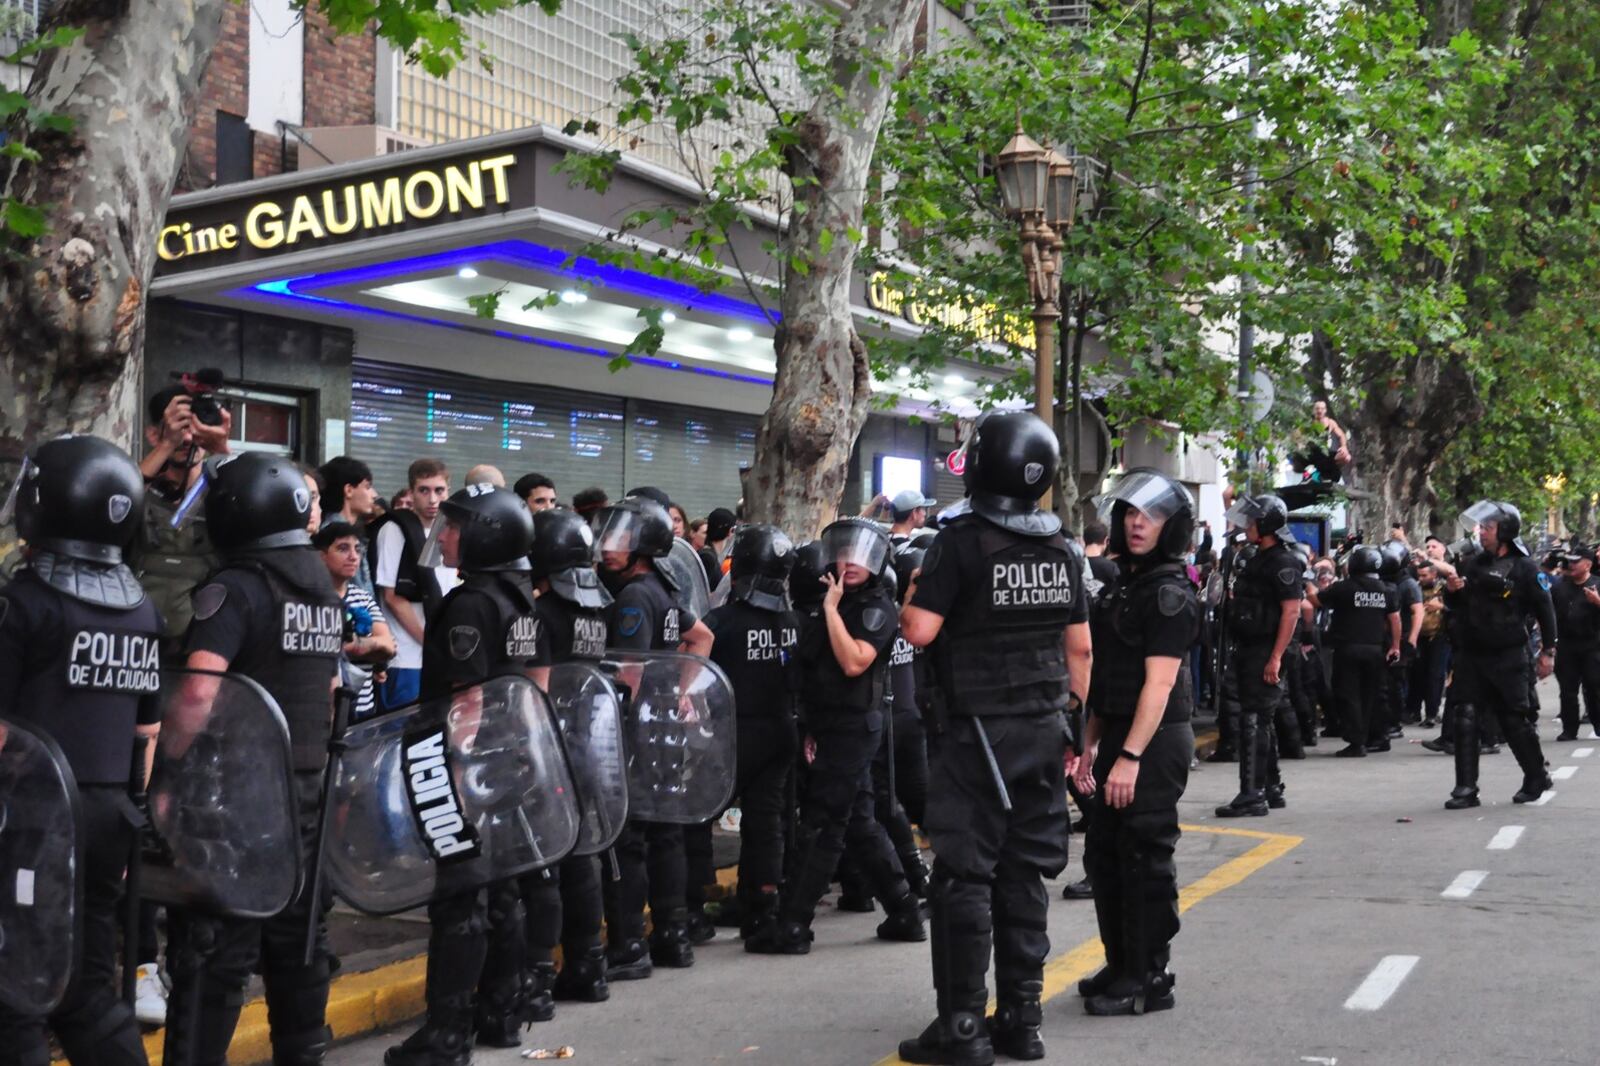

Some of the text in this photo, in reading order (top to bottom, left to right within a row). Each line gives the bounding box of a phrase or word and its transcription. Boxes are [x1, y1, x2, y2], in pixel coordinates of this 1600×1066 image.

[157, 154, 515, 261] Cine GAUMONT
[993, 562, 1070, 589] POLICIA
[993, 588, 1071, 606] DE LA CIUDAD
[1354, 591, 1386, 602] POLICIA
[284, 602, 343, 635] POLICIA
[71, 630, 159, 670] POLICIA
[283, 632, 342, 653] DE LA CIUDAD
[747, 628, 798, 649] POLCIA
[747, 648, 761, 661] DE
[762, 648, 774, 661] LA
[69, 663, 160, 692] DE LA CIUDAD
[407, 731, 475, 857] POLICIA
